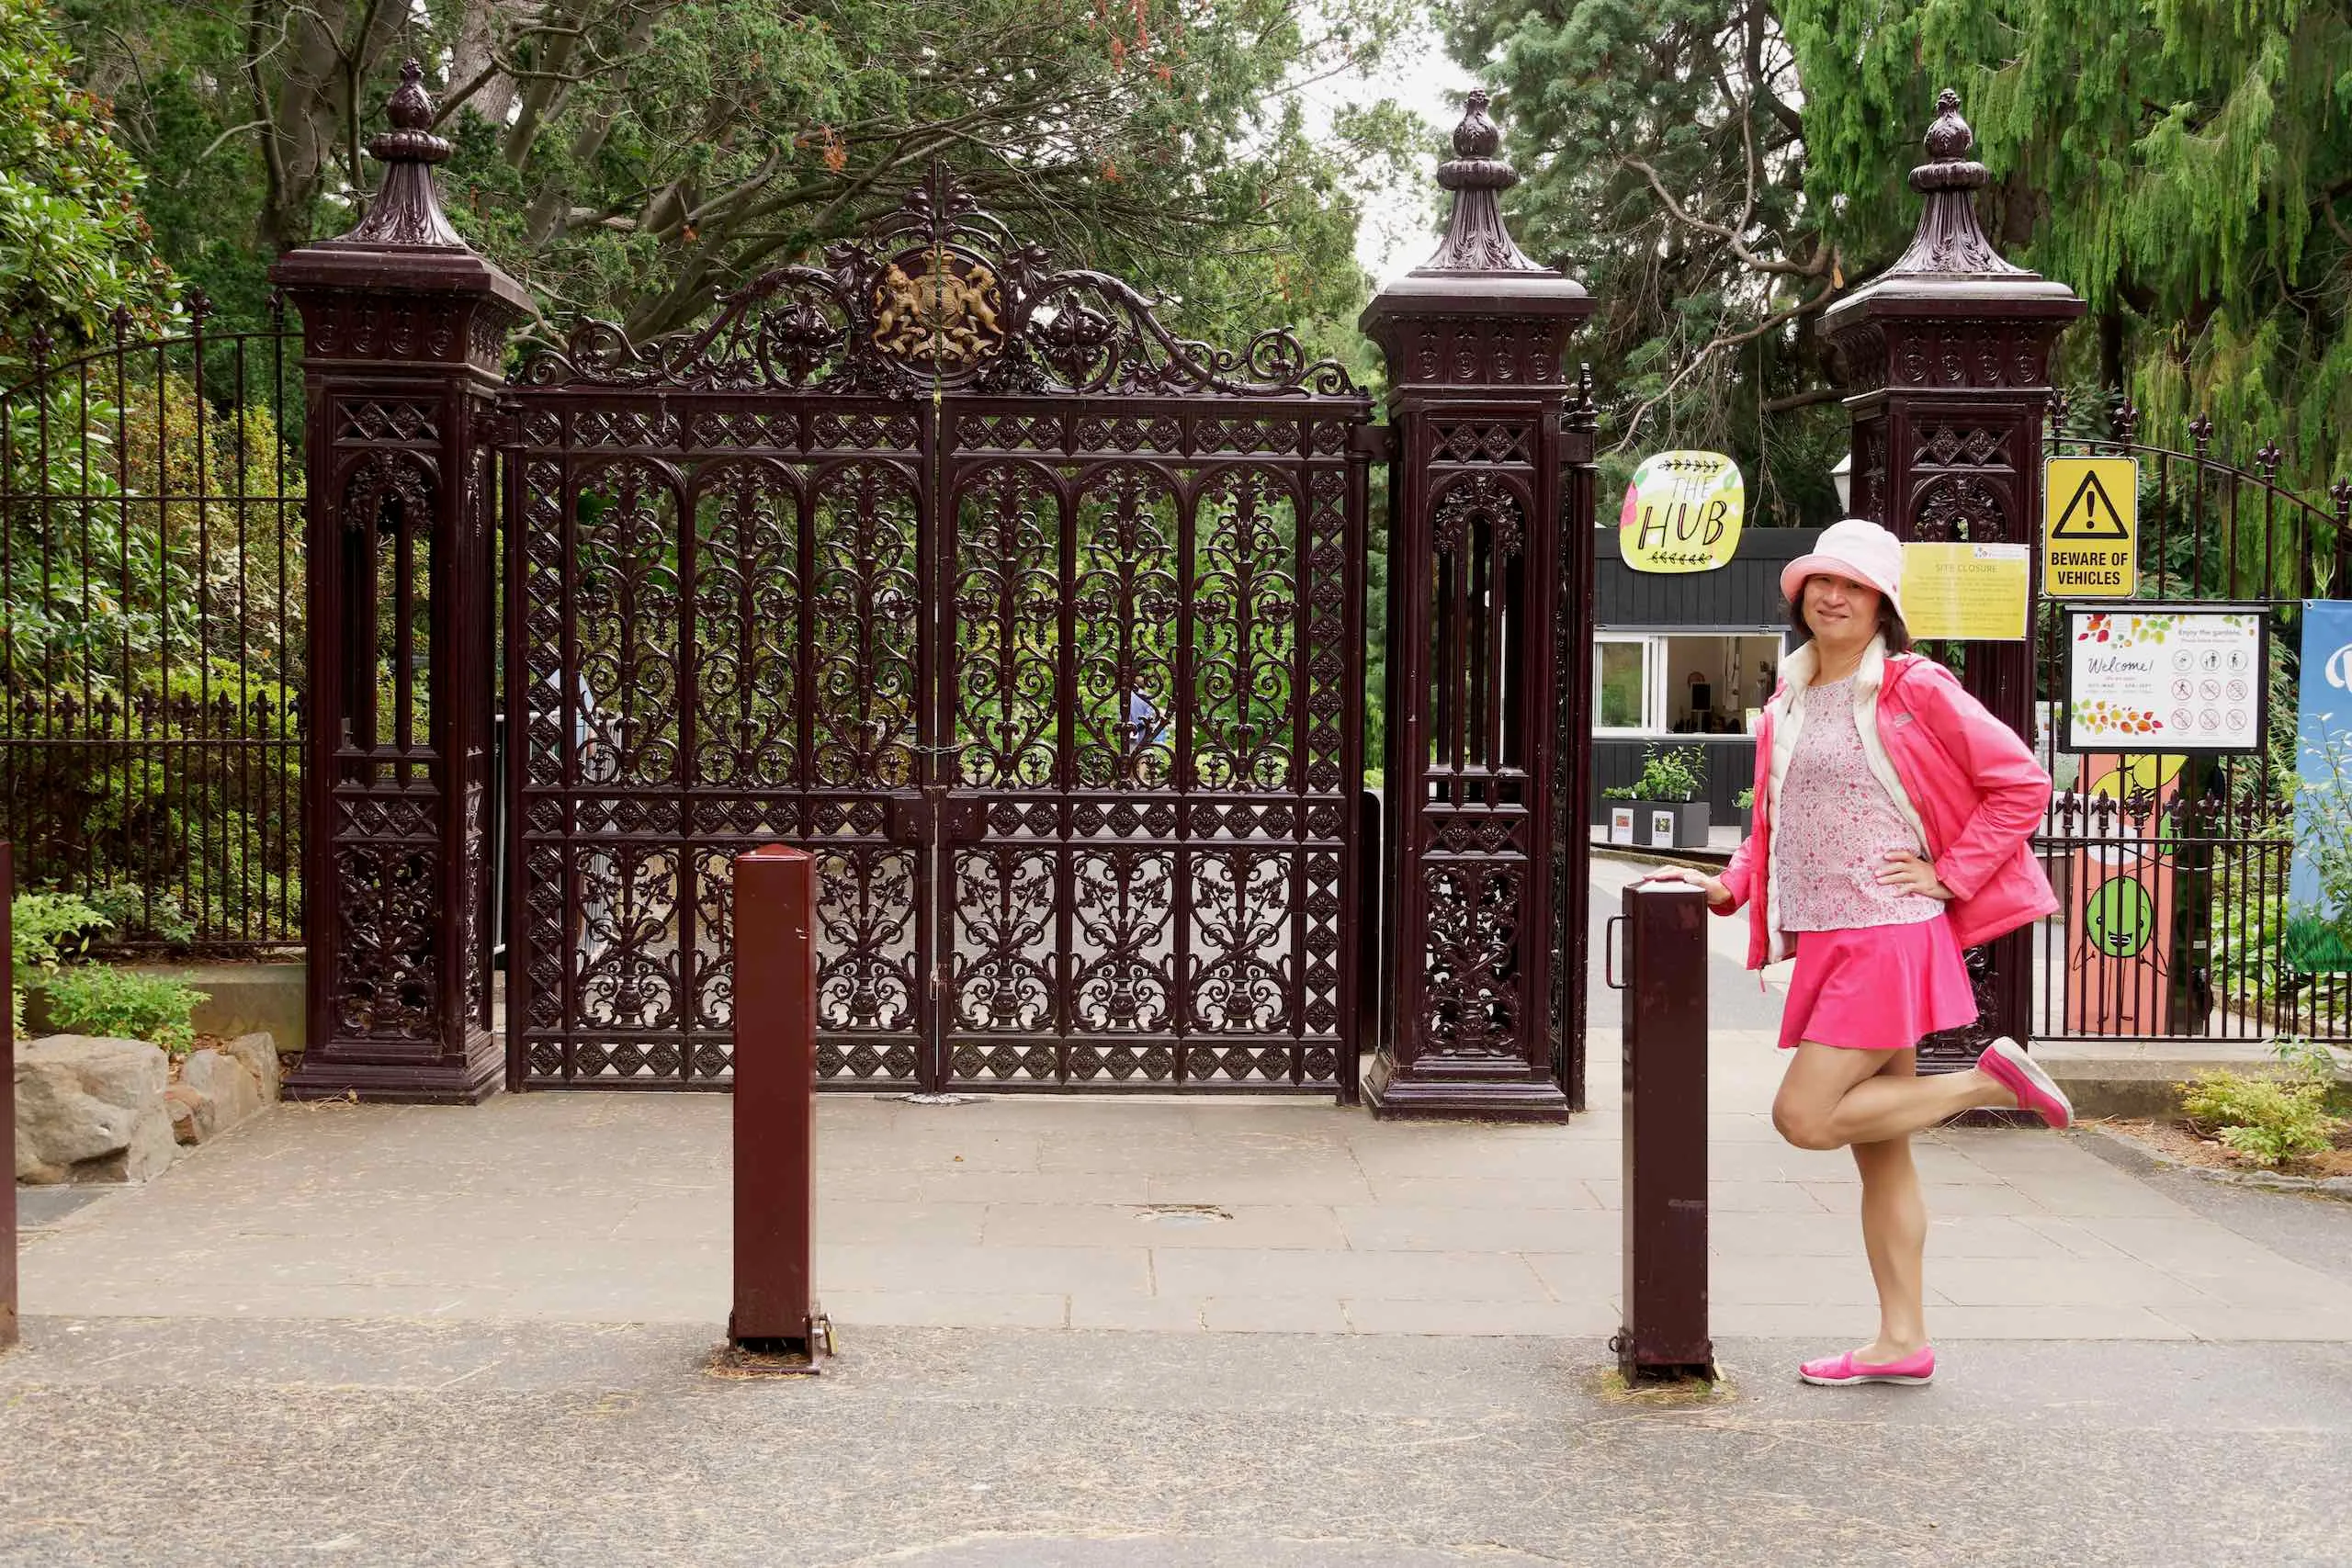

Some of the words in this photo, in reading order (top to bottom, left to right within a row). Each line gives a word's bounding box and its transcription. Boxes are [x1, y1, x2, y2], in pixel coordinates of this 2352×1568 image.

[1669, 475, 1716, 501] THE
[1638, 500, 1727, 550] HUB
[2051, 552, 2107, 566] BEWARE
[2111, 552, 2129, 566] OF
[1934, 563, 1955, 574] SITE
[1957, 564, 1999, 574] CLOSURE
[2057, 571, 2120, 585] VEHICLES
[2087, 655, 2154, 674] Welcome!
